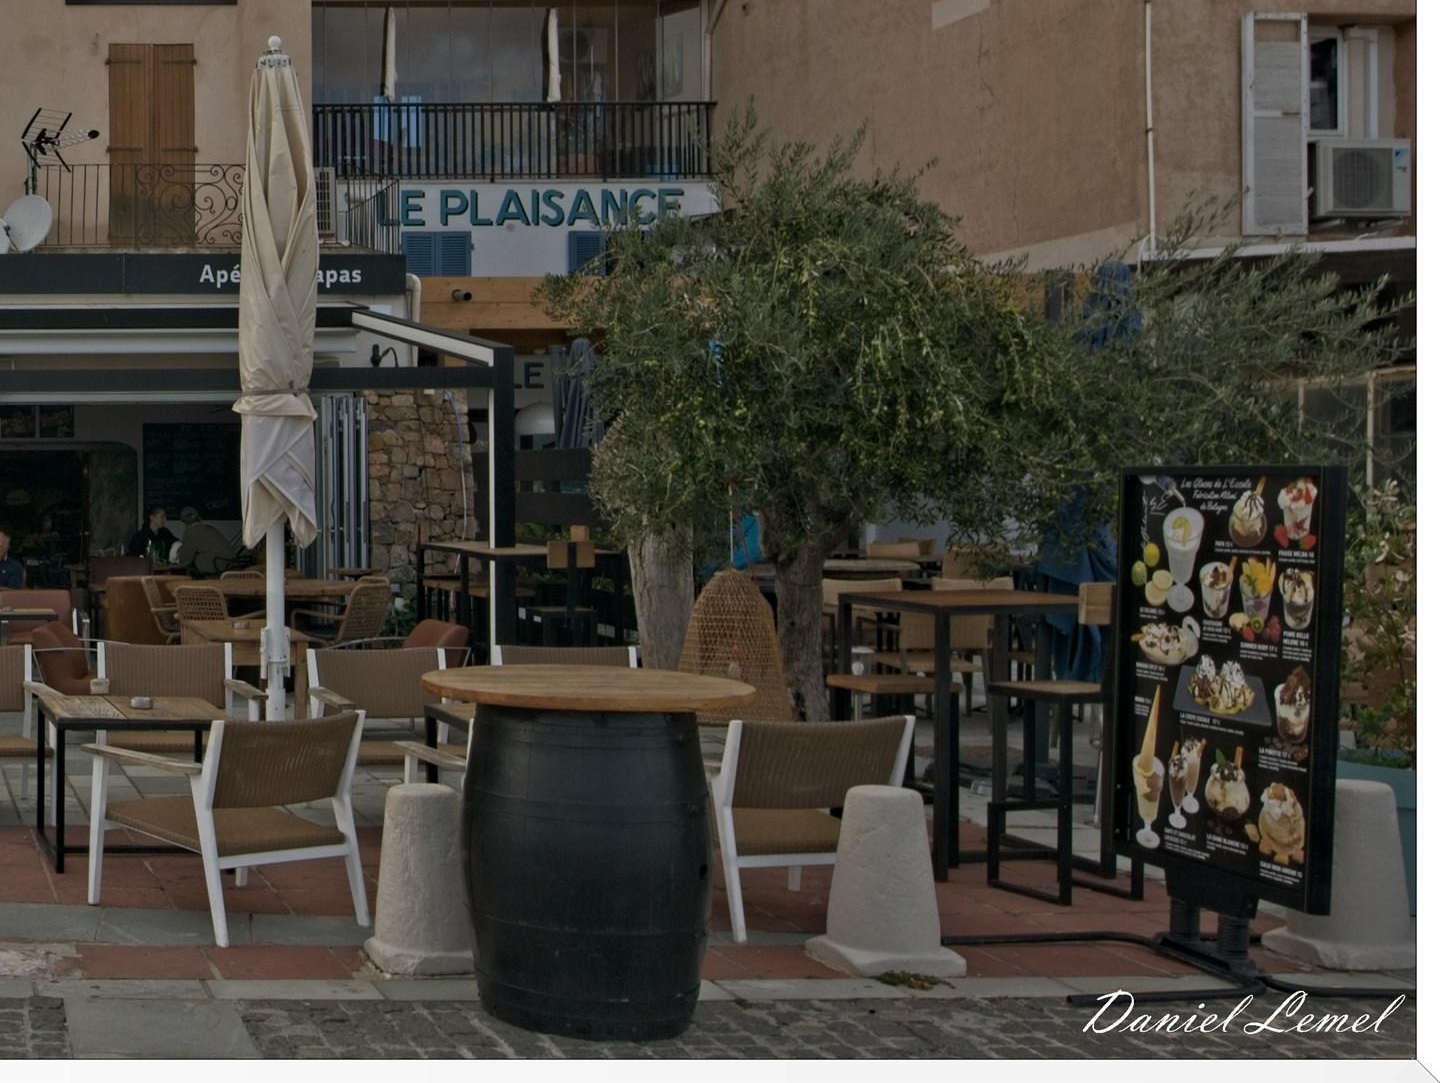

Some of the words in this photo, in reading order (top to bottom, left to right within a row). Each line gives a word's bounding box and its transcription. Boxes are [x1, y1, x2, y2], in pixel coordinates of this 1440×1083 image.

[380, 189, 425, 226] LE
[440, 188, 684, 227] PLAISANCE
[199, 264, 241, 289] Apé
[317, 268, 363, 288] apas
